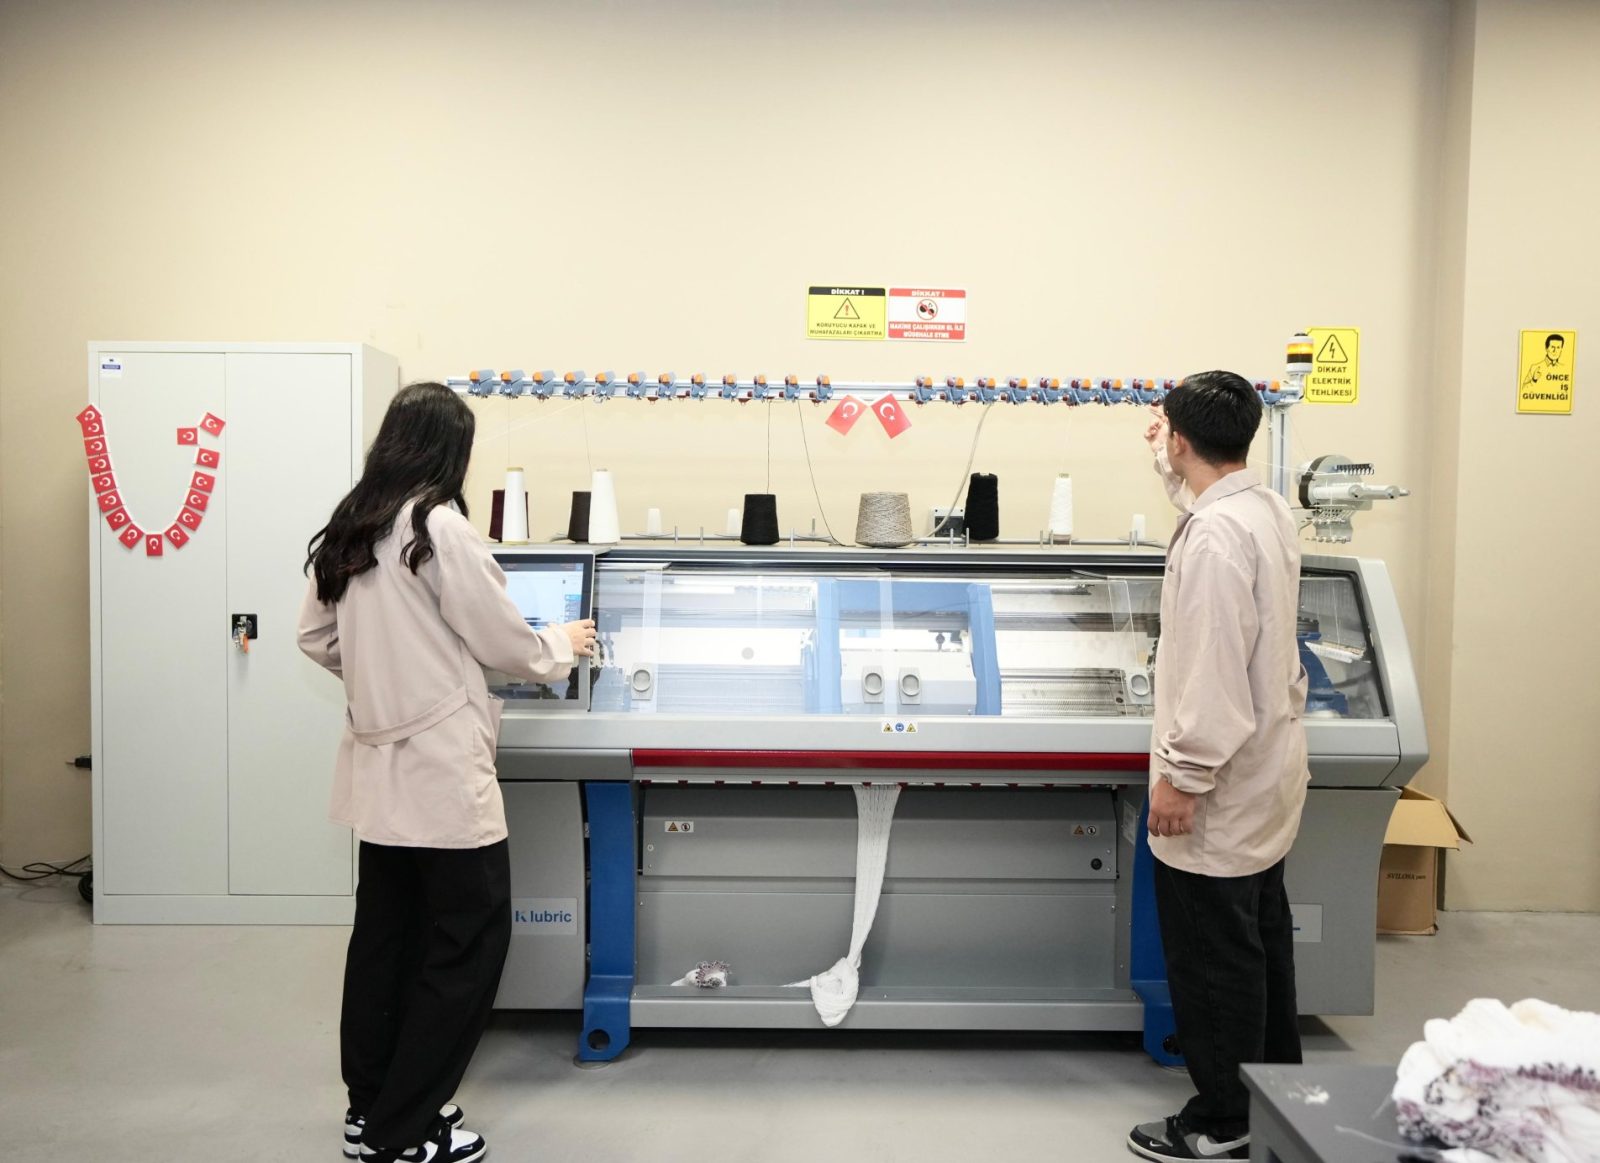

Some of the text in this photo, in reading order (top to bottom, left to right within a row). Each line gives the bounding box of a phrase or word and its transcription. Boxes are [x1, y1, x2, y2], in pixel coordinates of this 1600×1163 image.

[1545, 372, 1569, 381] ÖNCE
[1312, 377, 1351, 385] ELEKTRİK
[1311, 388, 1352, 396] TEHLİKESİ
